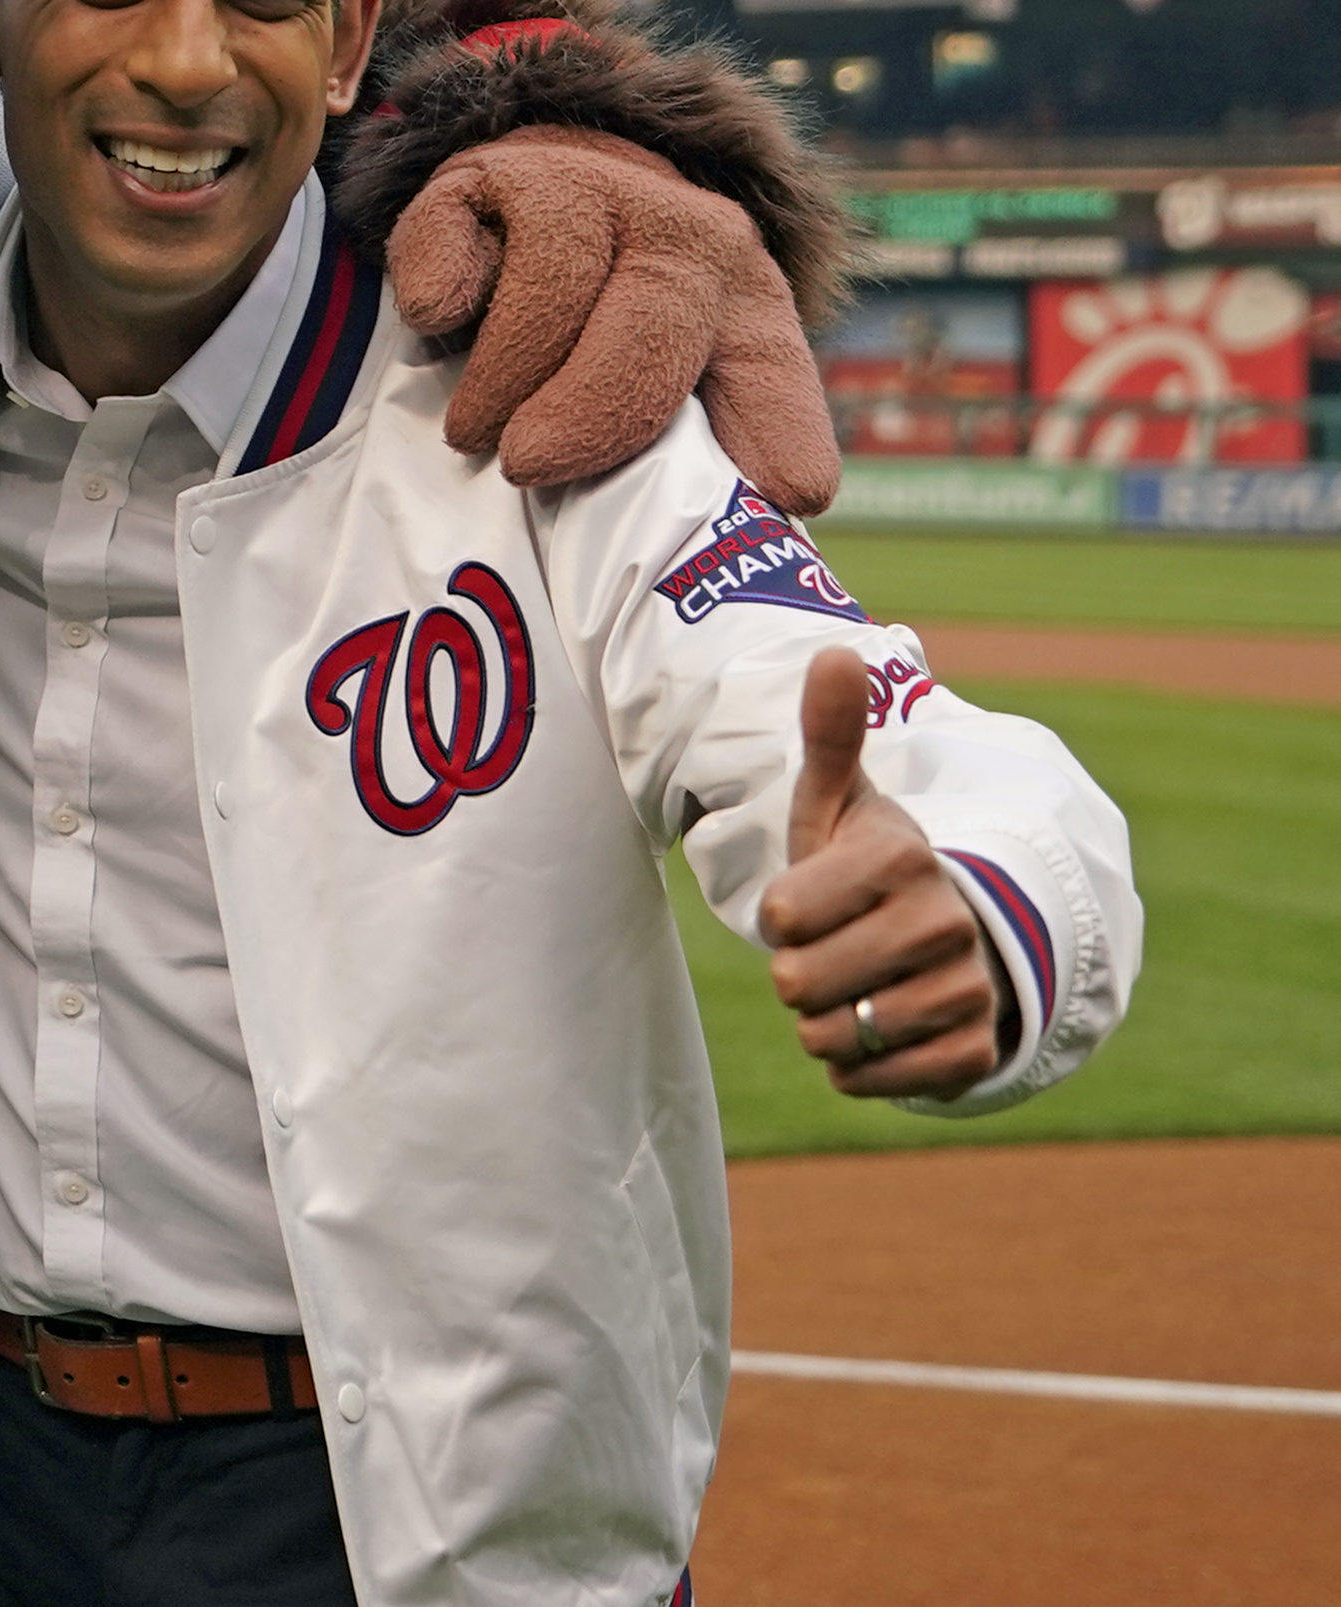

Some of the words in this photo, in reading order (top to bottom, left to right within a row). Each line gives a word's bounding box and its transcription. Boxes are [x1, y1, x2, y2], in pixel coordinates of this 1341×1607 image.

[662, 519, 788, 598] WORLD
[679, 536, 818, 620] CHAM
[305, 560, 537, 838] W
